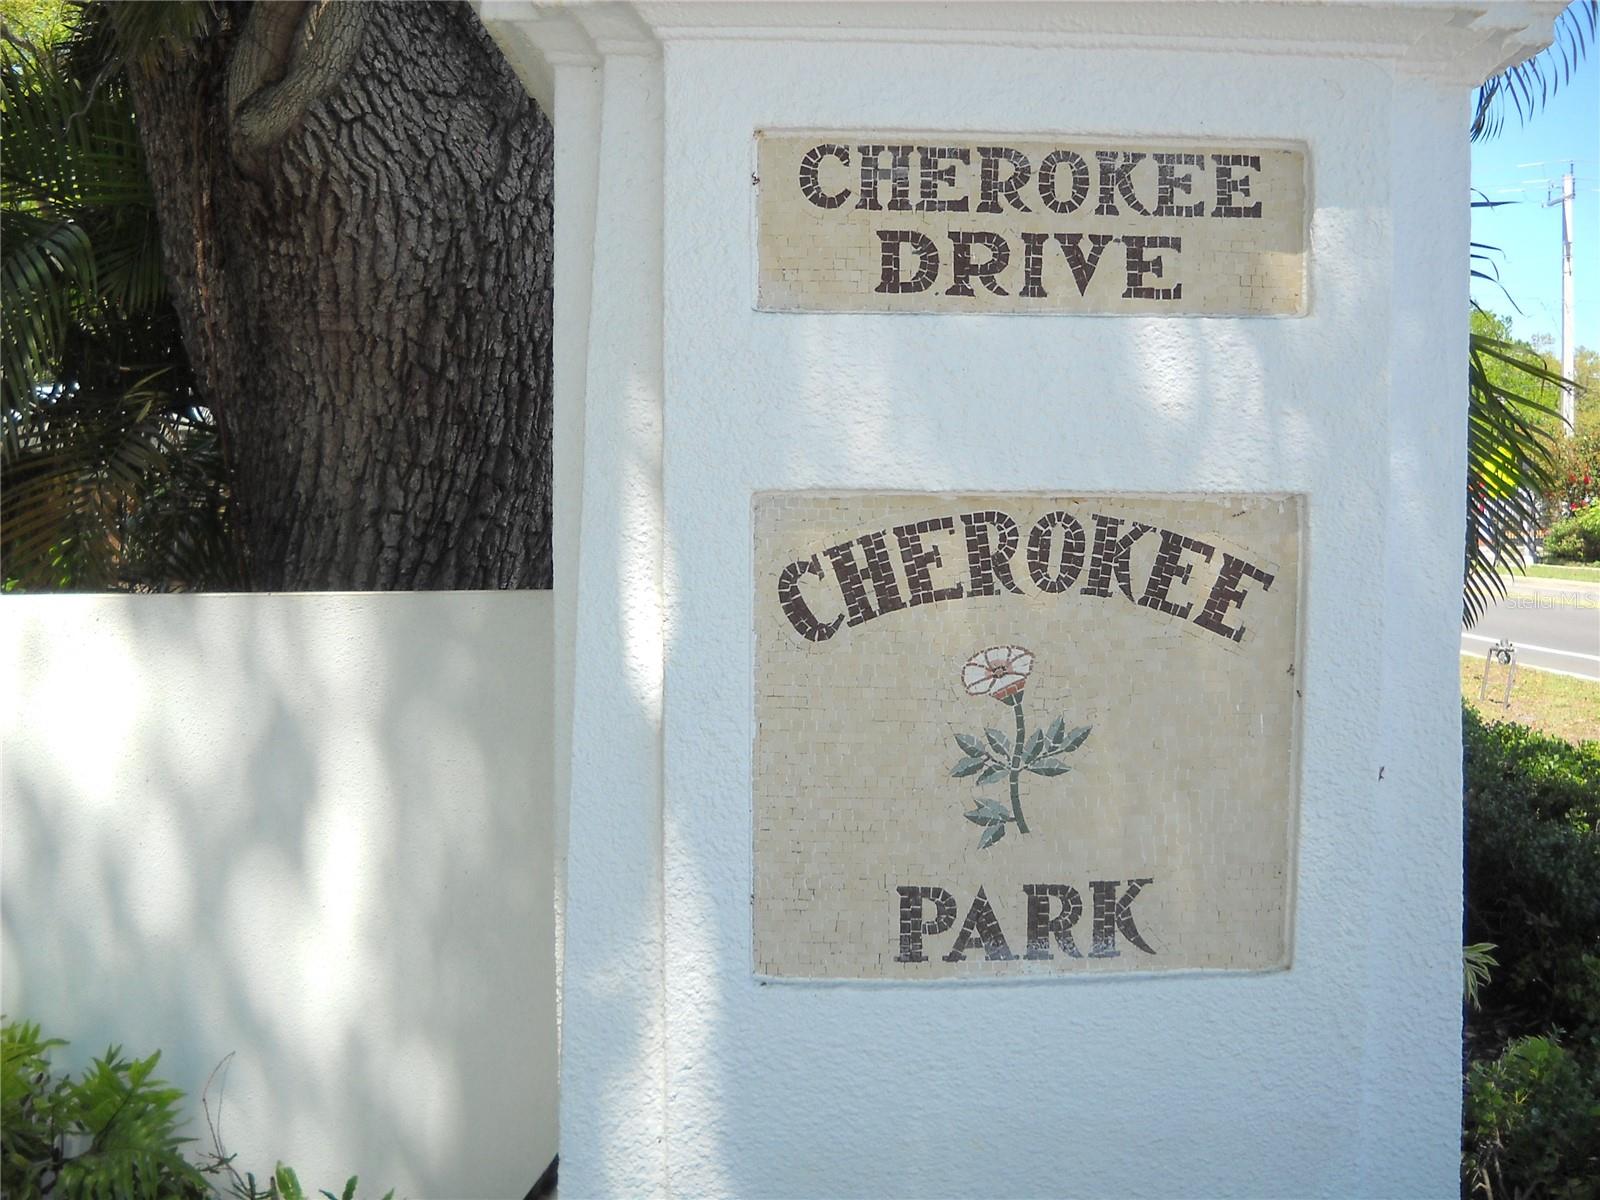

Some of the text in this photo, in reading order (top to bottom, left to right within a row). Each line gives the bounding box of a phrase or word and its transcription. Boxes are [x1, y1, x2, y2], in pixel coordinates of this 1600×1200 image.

[799, 143, 1262, 217] CHEROKEE
[874, 230, 1182, 299] DRIVE
[778, 511, 1274, 643] CHEROKEE
[894, 878, 1156, 962] PARK
